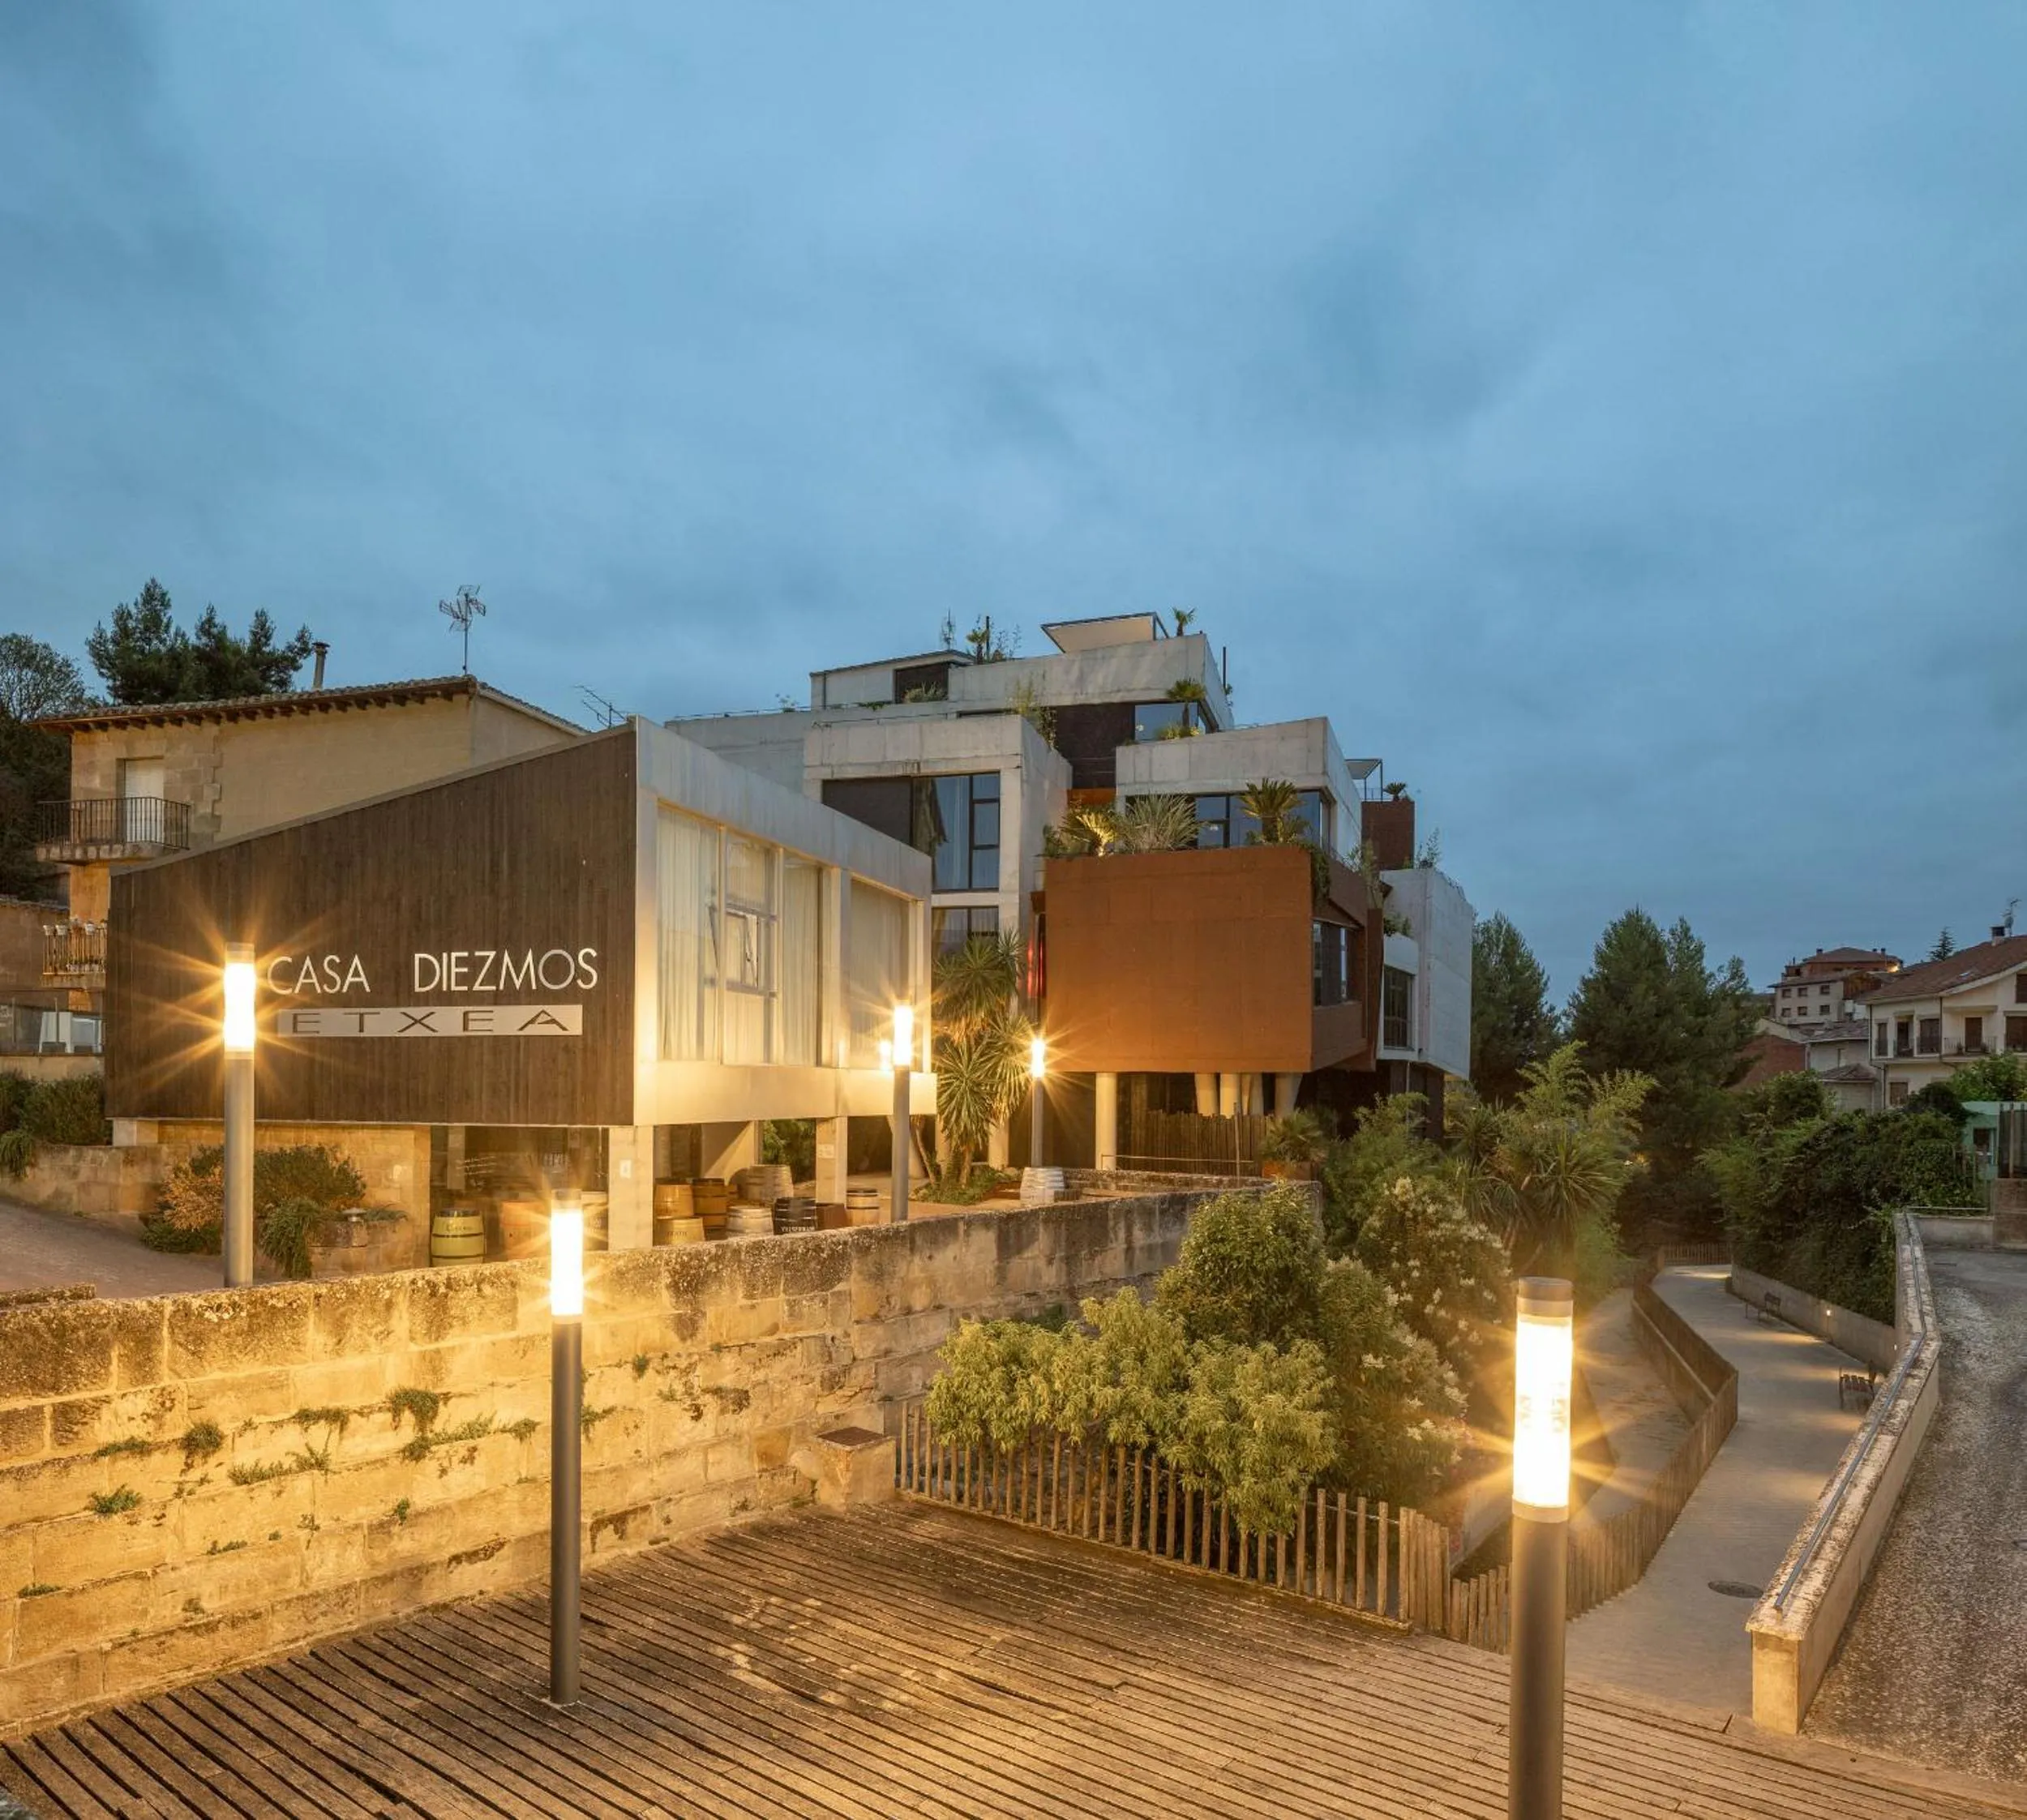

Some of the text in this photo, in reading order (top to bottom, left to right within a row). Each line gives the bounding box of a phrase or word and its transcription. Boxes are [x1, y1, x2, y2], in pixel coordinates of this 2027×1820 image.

[268, 948, 598, 995] CASA DIEZMOS
[291, 1008, 570, 1034] ETXEA
